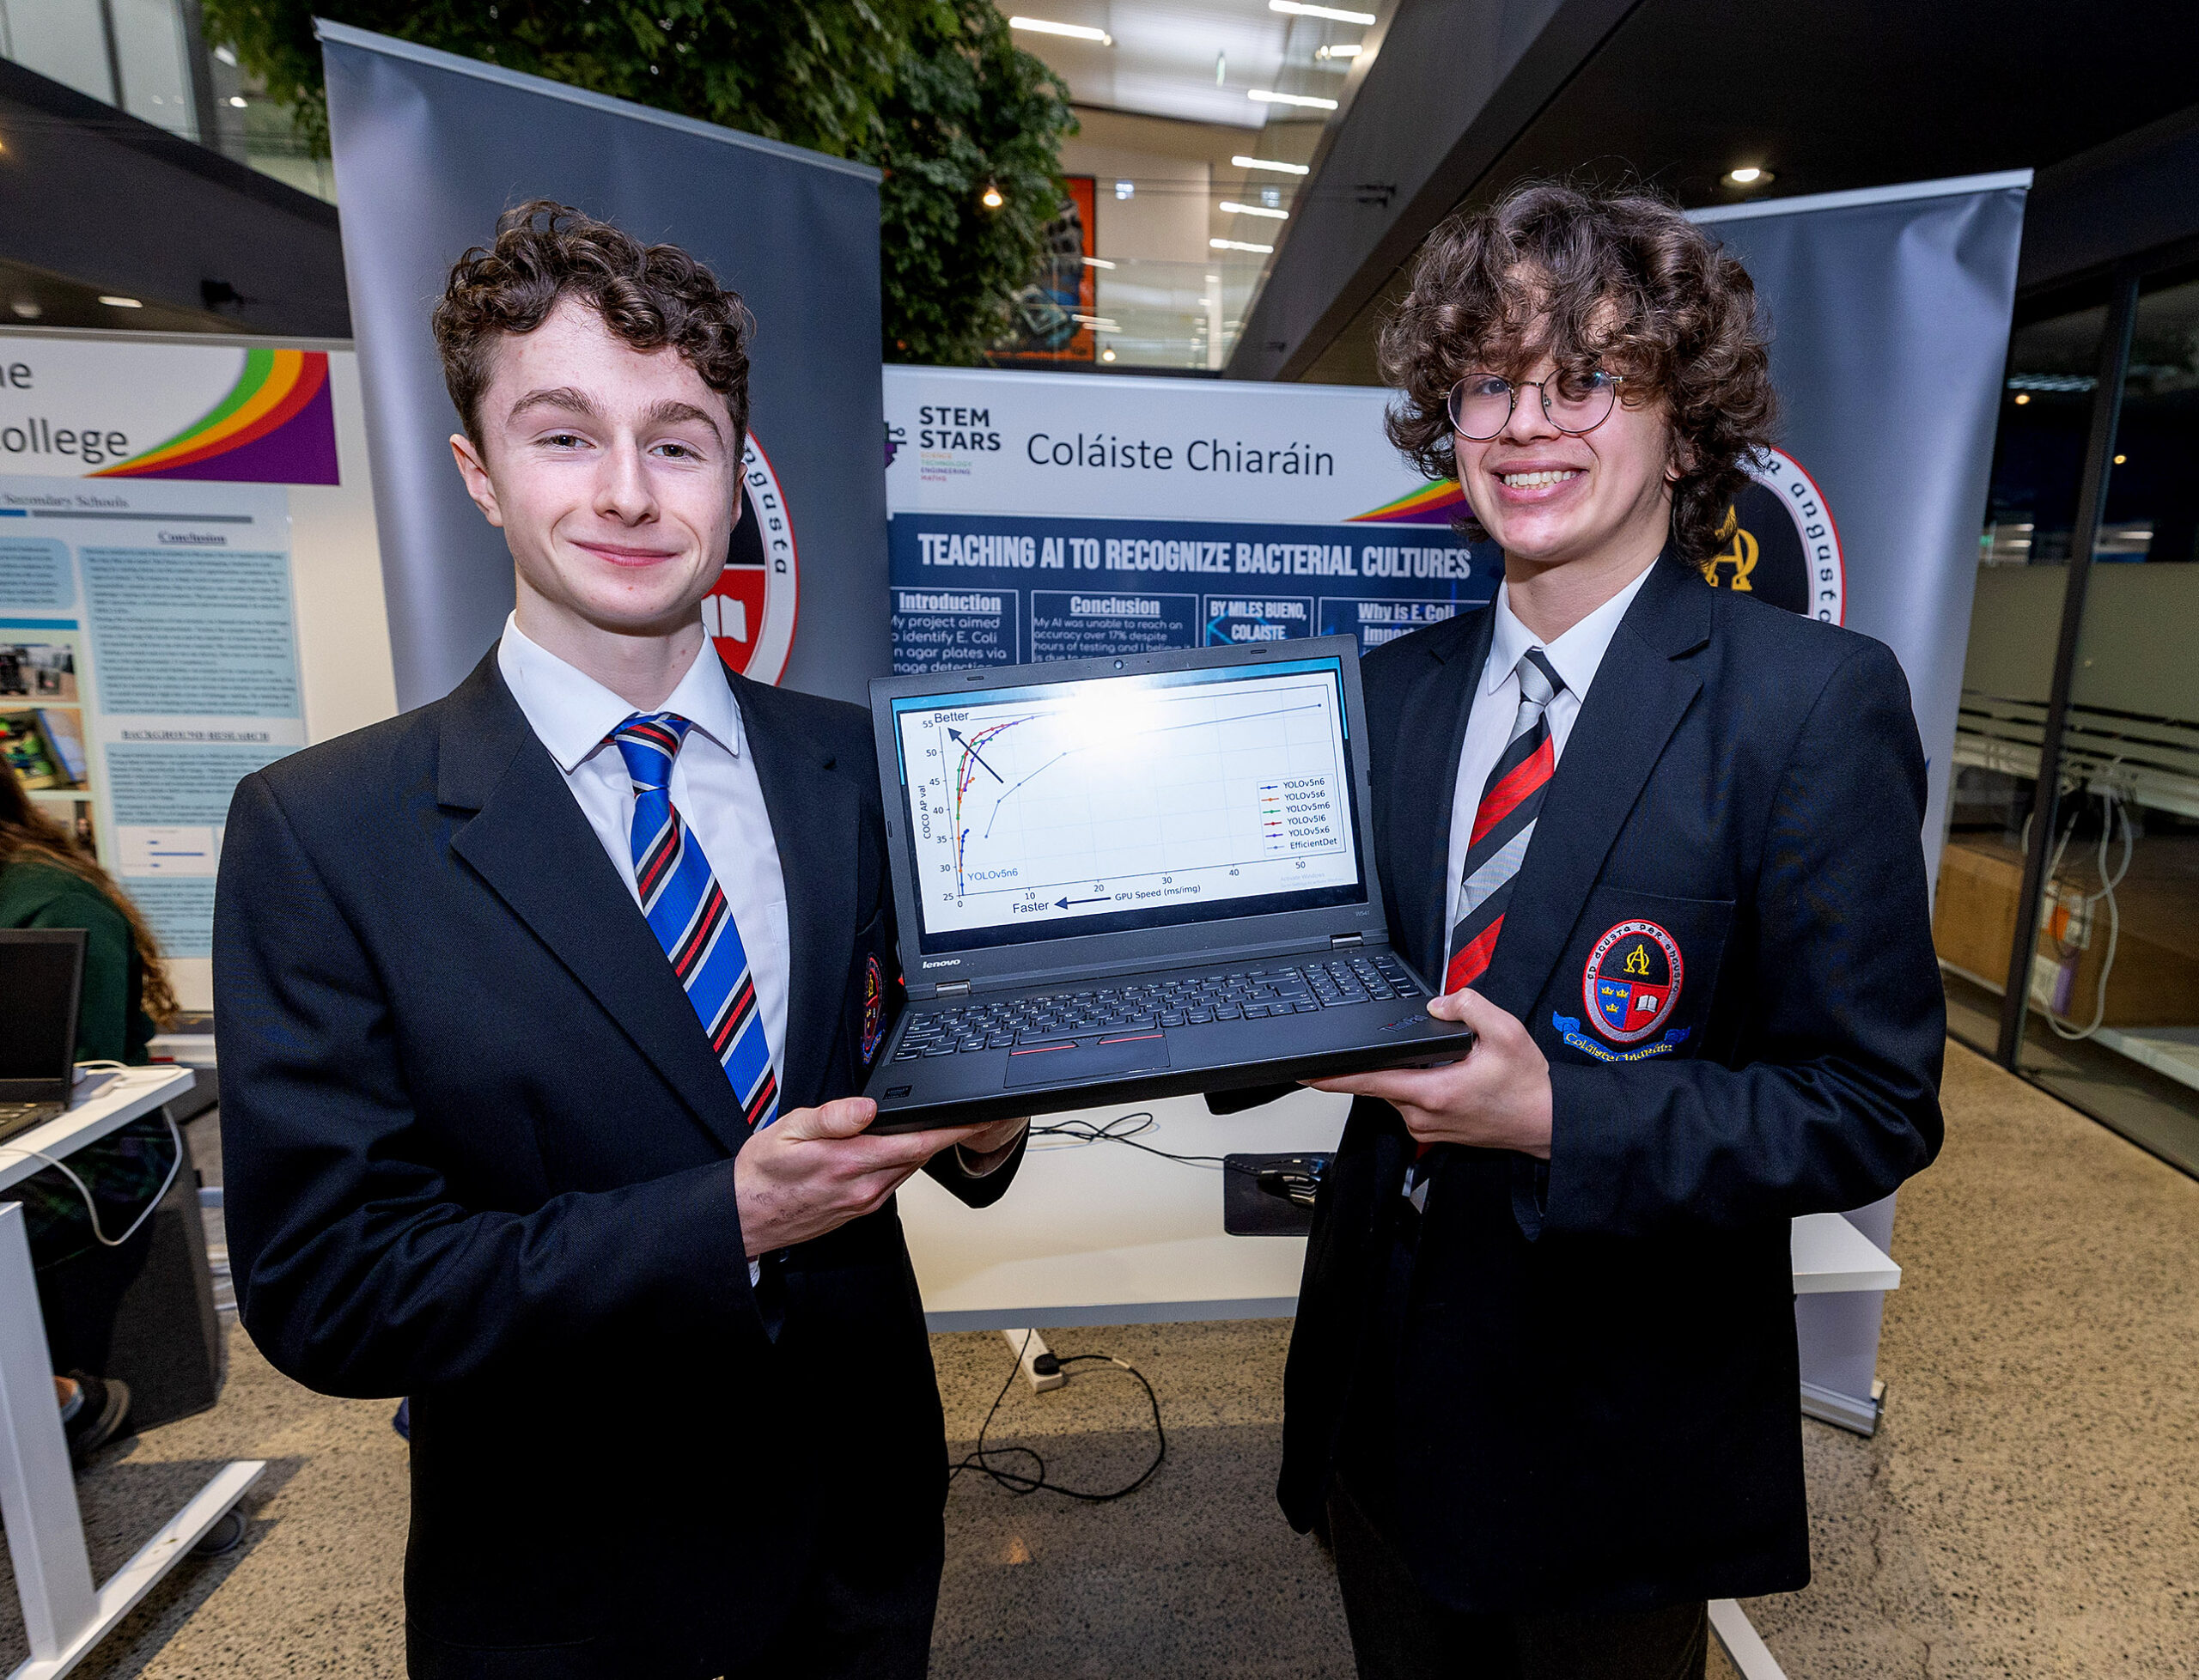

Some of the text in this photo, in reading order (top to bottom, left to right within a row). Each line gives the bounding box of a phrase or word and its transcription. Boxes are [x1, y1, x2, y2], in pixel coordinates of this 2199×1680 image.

[920, 406, 990, 427] STEM
[0, 417, 128, 465] ollege
[920, 430, 1001, 451] STARS
[1026, 433, 1334, 477] Coláiste Chiaráin
[921, 466, 971, 475] ENGINEERING
[917, 533, 1472, 580] TEACHING AI TO RECOGNIZE BACTERIAL CULTURES
[898, 592, 1002, 612] Introduction
[1070, 595, 1161, 617] Conclusion
[1209, 600, 1307, 621] BY MILES BUENO,
[1358, 602, 1392, 621] Why
[1394, 603, 1409, 620] is
[908, 615, 956, 630] project
[958, 617, 1002, 629] aimed
[1034, 618, 1050, 630] My
[1064, 619, 1085, 629] was
[1086, 618, 1123, 629] unable
[1124, 620, 1136, 629] to
[1137, 620, 1168, 630] reach
[1168, 621, 1184, 630] an
[903, 630, 953, 645] identify
[956, 631, 969, 643] E.
[972, 631, 998, 644] Coli
[1034, 630, 1168, 642] accuracy over 17% despite
[1231, 624, 1287, 641] COLAISTE
[906, 648, 939, 660] agar
[941, 646, 984, 660] plates
[986, 647, 1008, 659] via
[1034, 641, 1065, 652] hours
[1066, 641, 1078, 652] of
[1079, 642, 1117, 654] testing
[1117, 642, 1139, 653] and
[934, 712, 969, 724] Better
[926, 749, 937, 758] 50
[1282, 777, 1325, 789] YOLOv5n6
[1284, 789, 1326, 801] YOLOv5s6
[917, 785, 932, 839] COCO AP val
[1285, 801, 1331, 813] YOLOv5m6
[1288, 825, 1331, 837] YOLOv5x6
[1289, 837, 1338, 849] EfficientDet
[1295, 861, 1307, 869] 50
[967, 867, 1020, 881] YOLOv5n6
[1228, 868, 1240, 877] 40
[1161, 876, 1173, 885] 30
[1093, 884, 1105, 892] 20
[1114, 885, 1201, 902] GPU Speed (ms/img)
[1025, 892, 1036, 900] 10
[1012, 901, 1050, 914] Faster
[922, 959, 961, 969] lenovo
